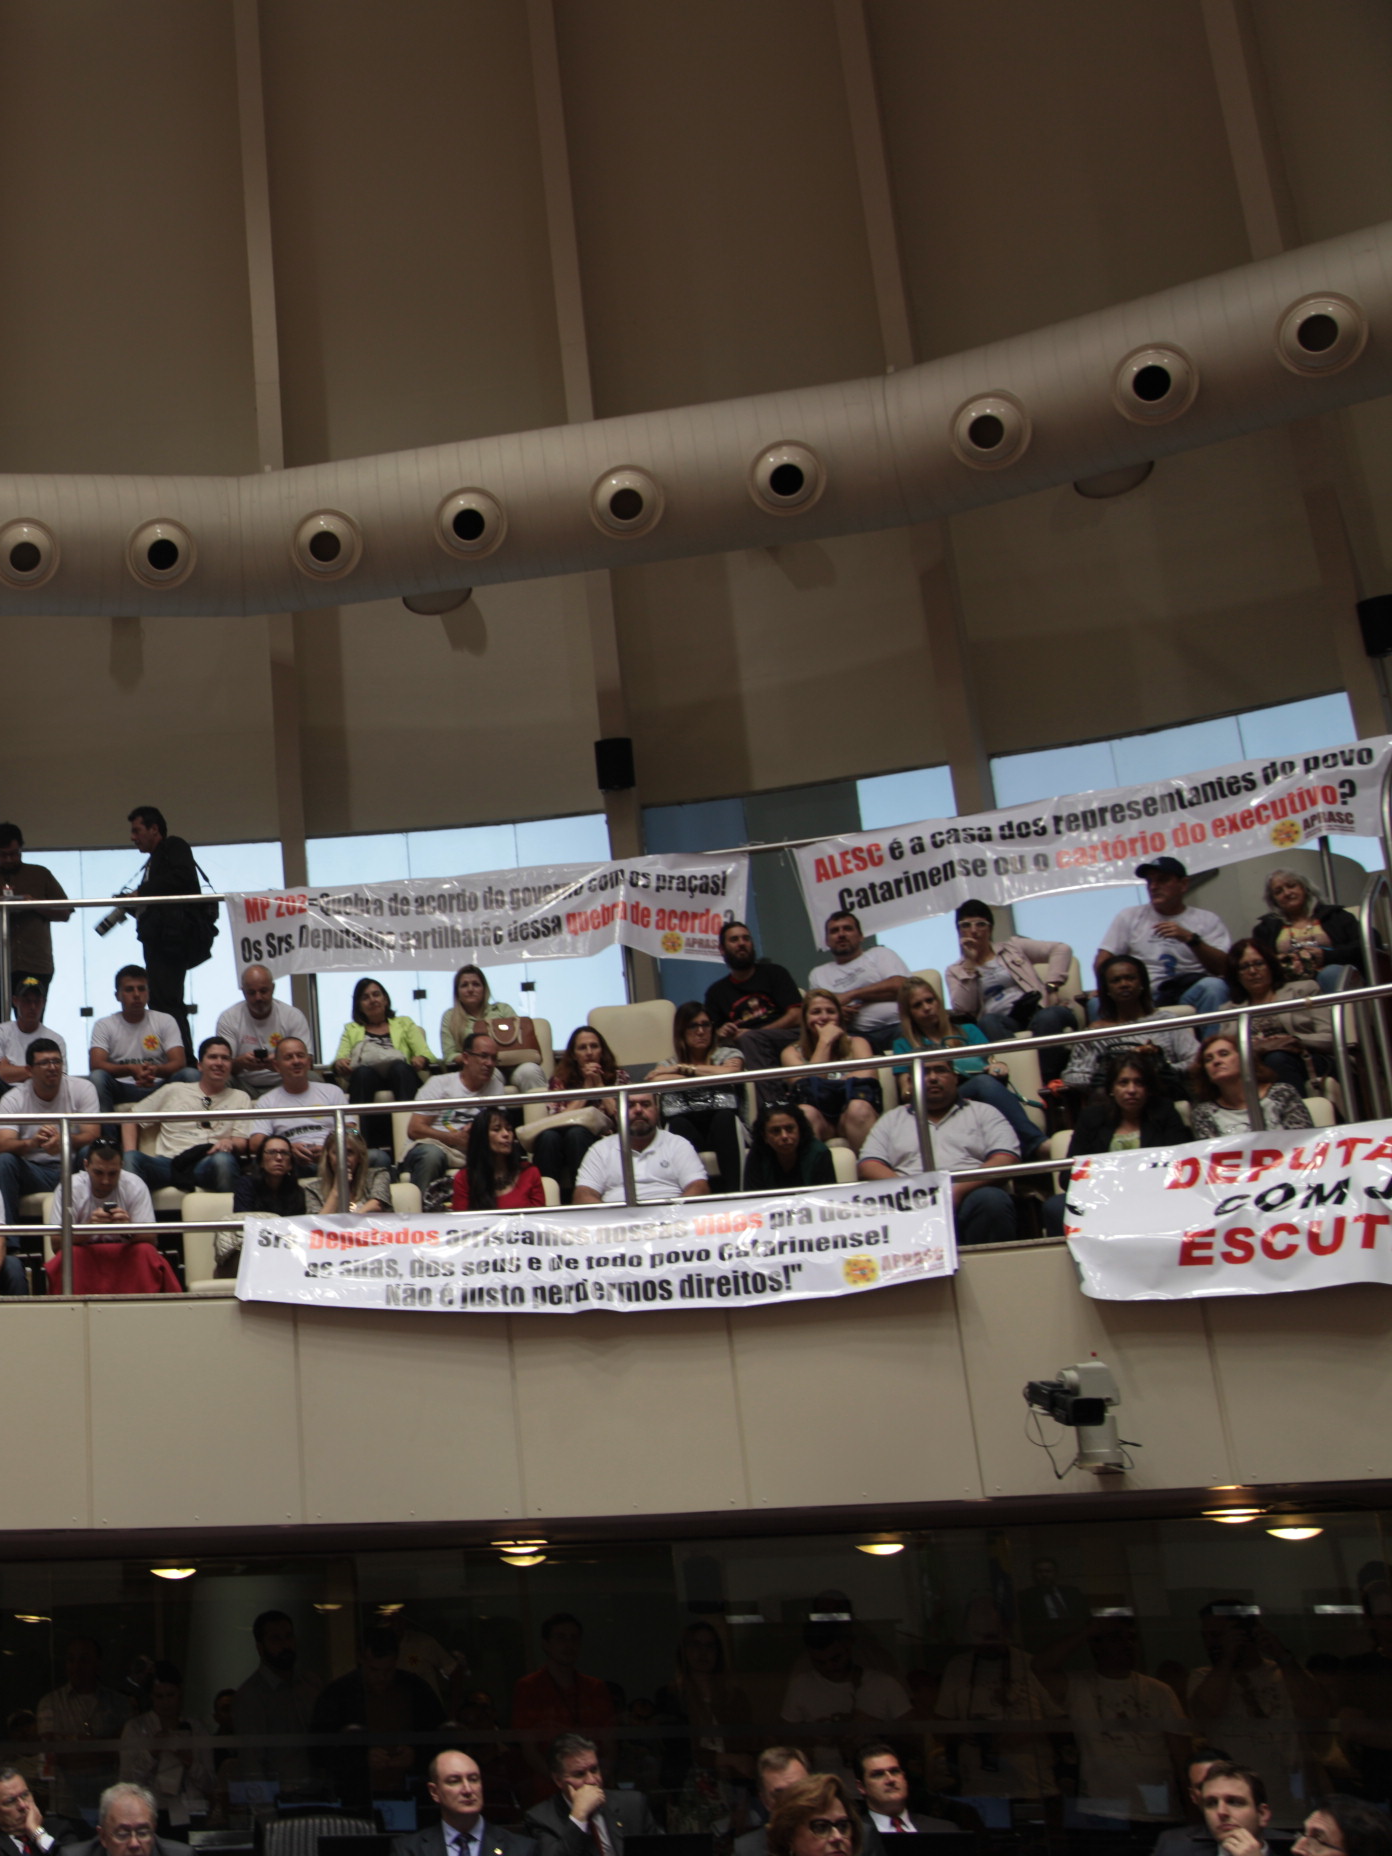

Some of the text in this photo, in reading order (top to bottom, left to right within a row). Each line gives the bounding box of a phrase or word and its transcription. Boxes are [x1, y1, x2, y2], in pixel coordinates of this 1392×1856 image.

[814, 747, 1373, 883] ALESC é a casa dos representantes do povo
[838, 854, 988, 914] Catarinense
[993, 852, 1027, 876] ou
[1033, 852, 1049, 872] o
[1056, 831, 1165, 868] cartório
[1172, 822, 1206, 849] do
[1211, 779, 1356, 838] executivo?
[244, 898, 270, 924] MP
[388, 893, 409, 916] de
[414, 889, 479, 916] acordo
[482, 886, 505, 912] do
[588, 868, 625, 893] com
[629, 870, 651, 889] os
[655, 870, 727, 898] praças!
[240, 936, 263, 963] Os
[265, 932, 295, 959] Srs.
[299, 924, 396, 952] Deputados
[400, 921, 503, 951] partilharão
[508, 913, 563, 943] dessa
[566, 900, 627, 936] quebra
[630, 901, 651, 928] de
[685, 937, 720, 949] APRAS
[309, 1228, 440, 1251] Deputados
[445, 1226, 590, 1248] arriscamos
[595, 1220, 688, 1243] nossas
[693, 1211, 764, 1236] vidas
[769, 1206, 812, 1230] pra
[819, 1185, 940, 1223] defender
[1214, 1177, 1350, 1216] COM
[305, 1225, 889, 1279] as suas, dos seus e de todo povo Catarinense!
[1178, 1213, 1391, 1266] ESCUT
[385, 1283, 432, 1307] Não
[439, 1282, 454, 1307] é
[460, 1284, 525, 1309] justo
[532, 1277, 673, 1309] perdermos
